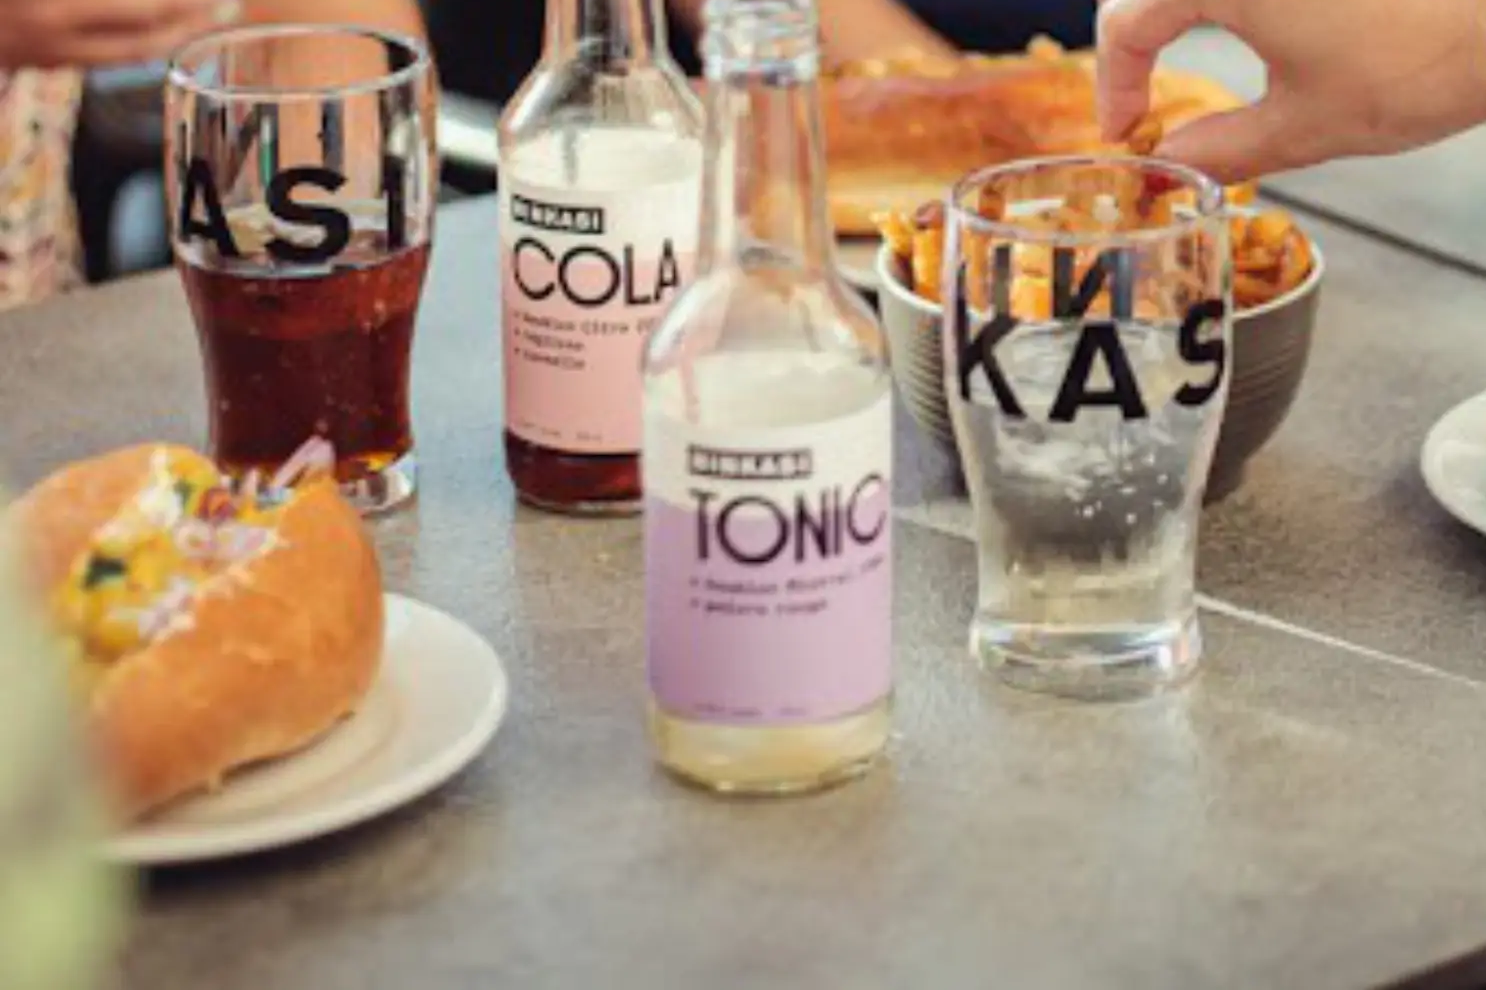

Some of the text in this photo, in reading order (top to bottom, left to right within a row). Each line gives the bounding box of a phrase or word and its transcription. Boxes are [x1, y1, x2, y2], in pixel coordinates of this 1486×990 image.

[512, 237, 680, 307] COLA
[957, 261, 1225, 422] KAS
[688, 472, 887, 566] TONIC
